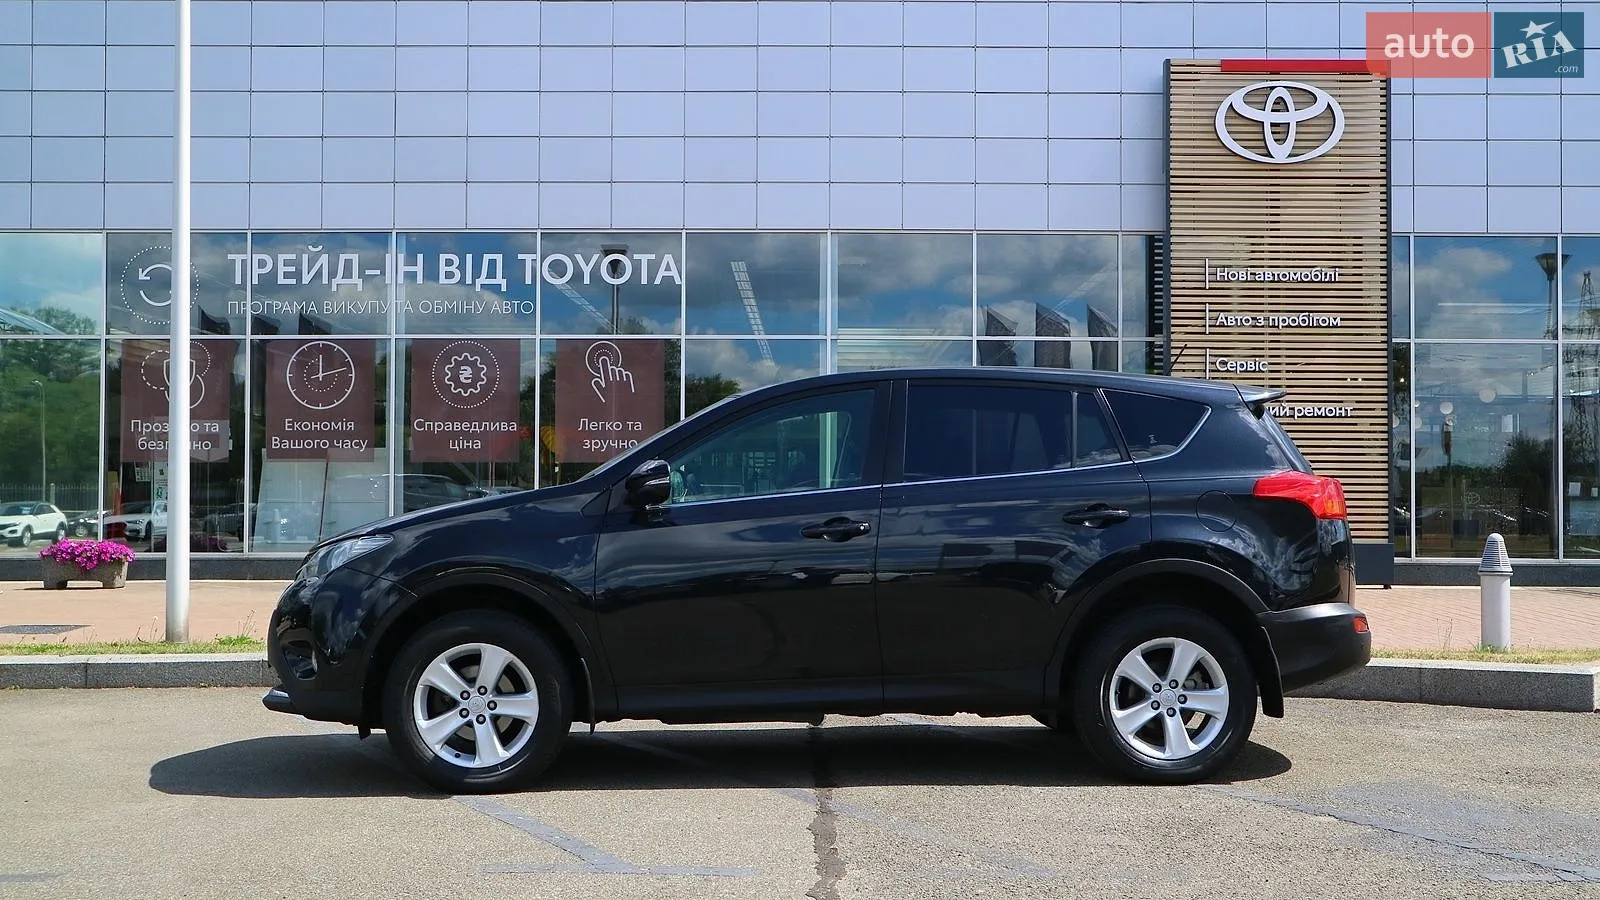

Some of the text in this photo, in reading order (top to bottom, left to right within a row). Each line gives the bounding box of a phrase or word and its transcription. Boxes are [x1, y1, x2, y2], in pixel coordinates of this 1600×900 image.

[227, 245, 683, 292] ТРЕЙД-ІН ВІД TOYOTA
[1216, 267, 1340, 281] Нові автомобілі
[228, 300, 319, 315] ПРОГРАМА
[323, 300, 391, 315] ВИКУПУ
[418, 300, 487, 315] ОБМІНУ
[490, 300, 535, 315] АВТО
[1216, 312, 1342, 330] Авто з пробігом
[1216, 357, 1269, 374] Сервіс
[1294, 406, 1354, 420] ремонт
[130, 420, 219, 436] Прозо та
[284, 418, 355, 432] Економія
[413, 418, 518, 433] Справедлива
[577, 418, 643, 431] Легко та
[271, 437, 369, 452] Вашого часу
[449, 437, 482, 451] ціна
[582, 439, 638, 452] зручно
